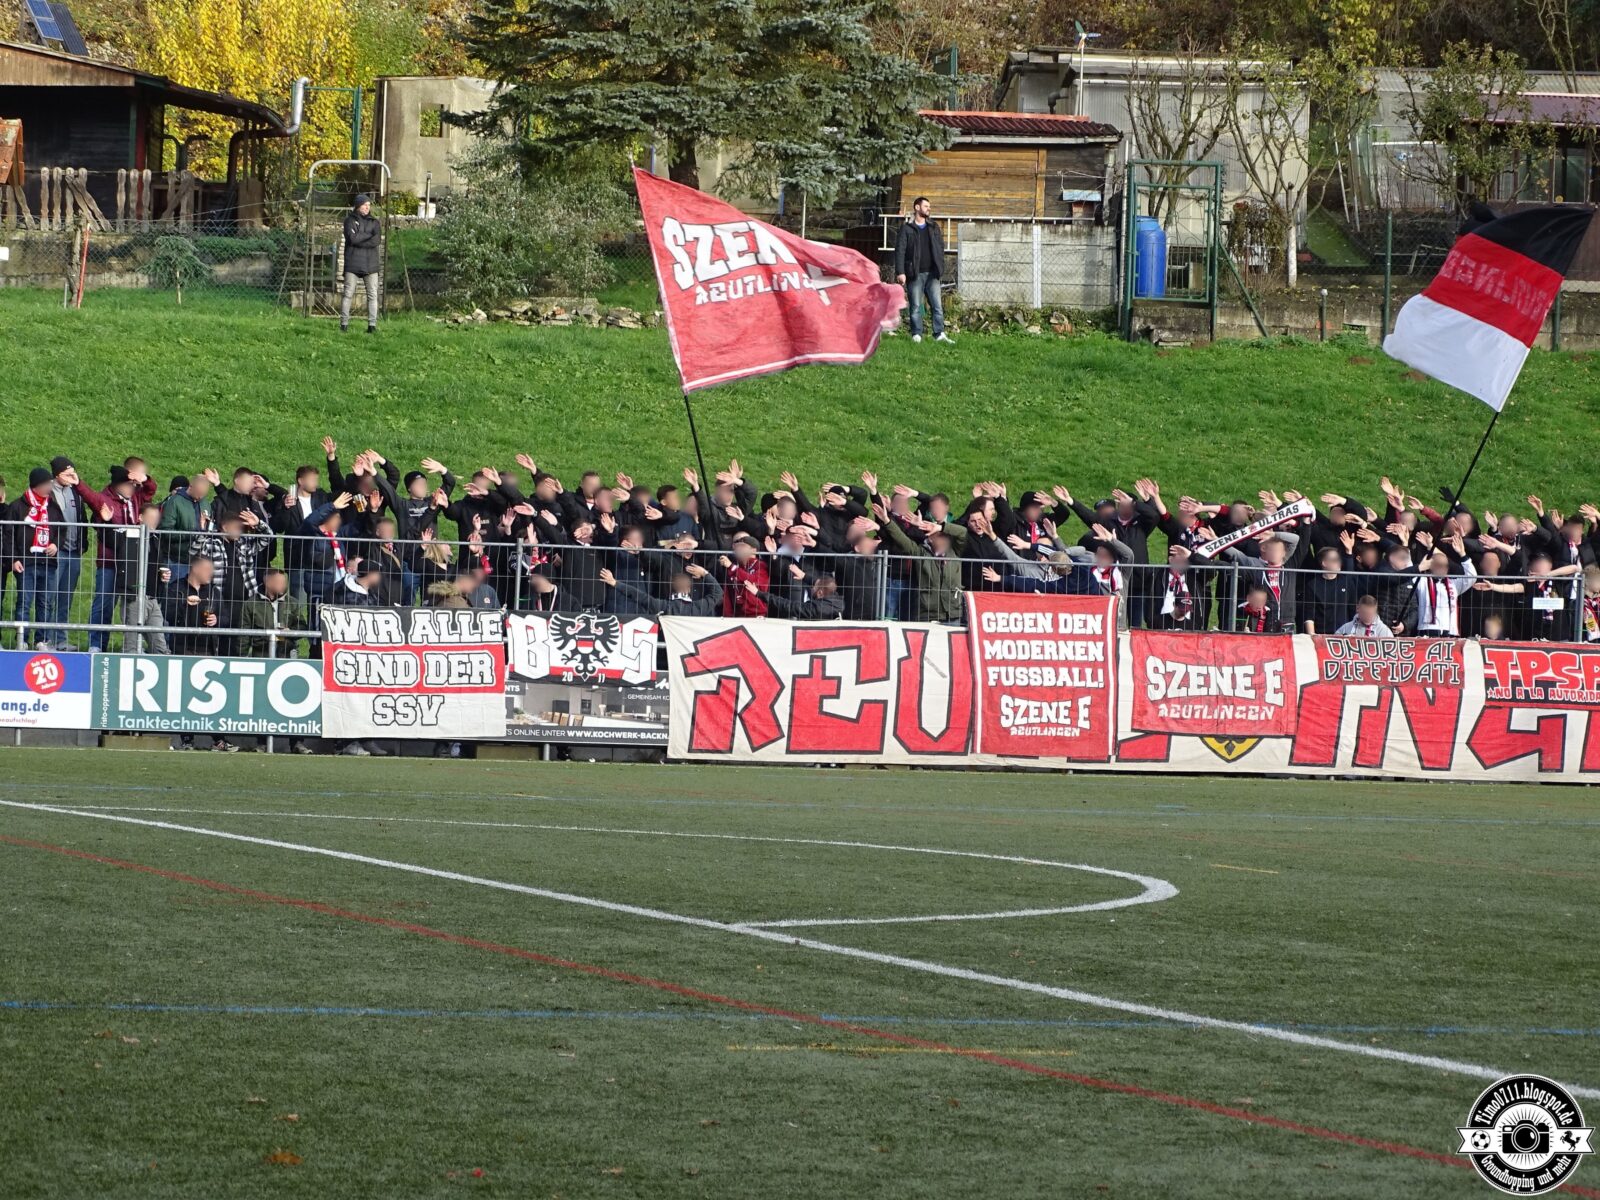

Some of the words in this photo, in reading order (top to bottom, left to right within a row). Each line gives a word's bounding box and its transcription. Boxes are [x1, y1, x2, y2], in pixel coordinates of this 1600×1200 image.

[1205, 533, 1239, 553] SZENE
[1240, 528, 1248, 537] E
[1258, 504, 1300, 528] ULTRAS
[321, 606, 404, 645] WIR
[409, 609, 503, 645] ALLE
[981, 611, 1054, 634] GEGEN
[1058, 613, 1104, 635] DEN
[983, 640, 1105, 662] MODERNEN
[1326, 637, 1416, 660] ONORE
[1426, 640, 1456, 663] AI
[32, 662, 59, 686] 20
[334, 648, 420, 688] SIND
[423, 650, 496, 688] DER
[562, 671, 573, 682] 20
[986, 666, 1105, 688] FUSSBALL!
[1323, 659, 1461, 684] DIFFIDATI
[101, 656, 110, 728] risto-oppenweiler.de
[118, 658, 321, 718] RISTO
[1145, 655, 1256, 701] SZENE
[1264, 658, 1285, 707] E
[1, 698, 49, 715] ang.de
[372, 694, 445, 726] SSV
[1000, 694, 1072, 728] SZENE
[1077, 695, 1092, 730] E
[1158, 703, 1275, 721] REUTLINGEN
[118, 715, 214, 731] Tanktechnik
[218, 717, 321, 734] Strahltechnik
[513, 729, 540, 737] ONLINE
[541, 729, 566, 737] UNTER
[566, 730, 669, 740] WWW.KOCHWERK-BACKN
[1010, 726, 1081, 737] REUTLINGEN
